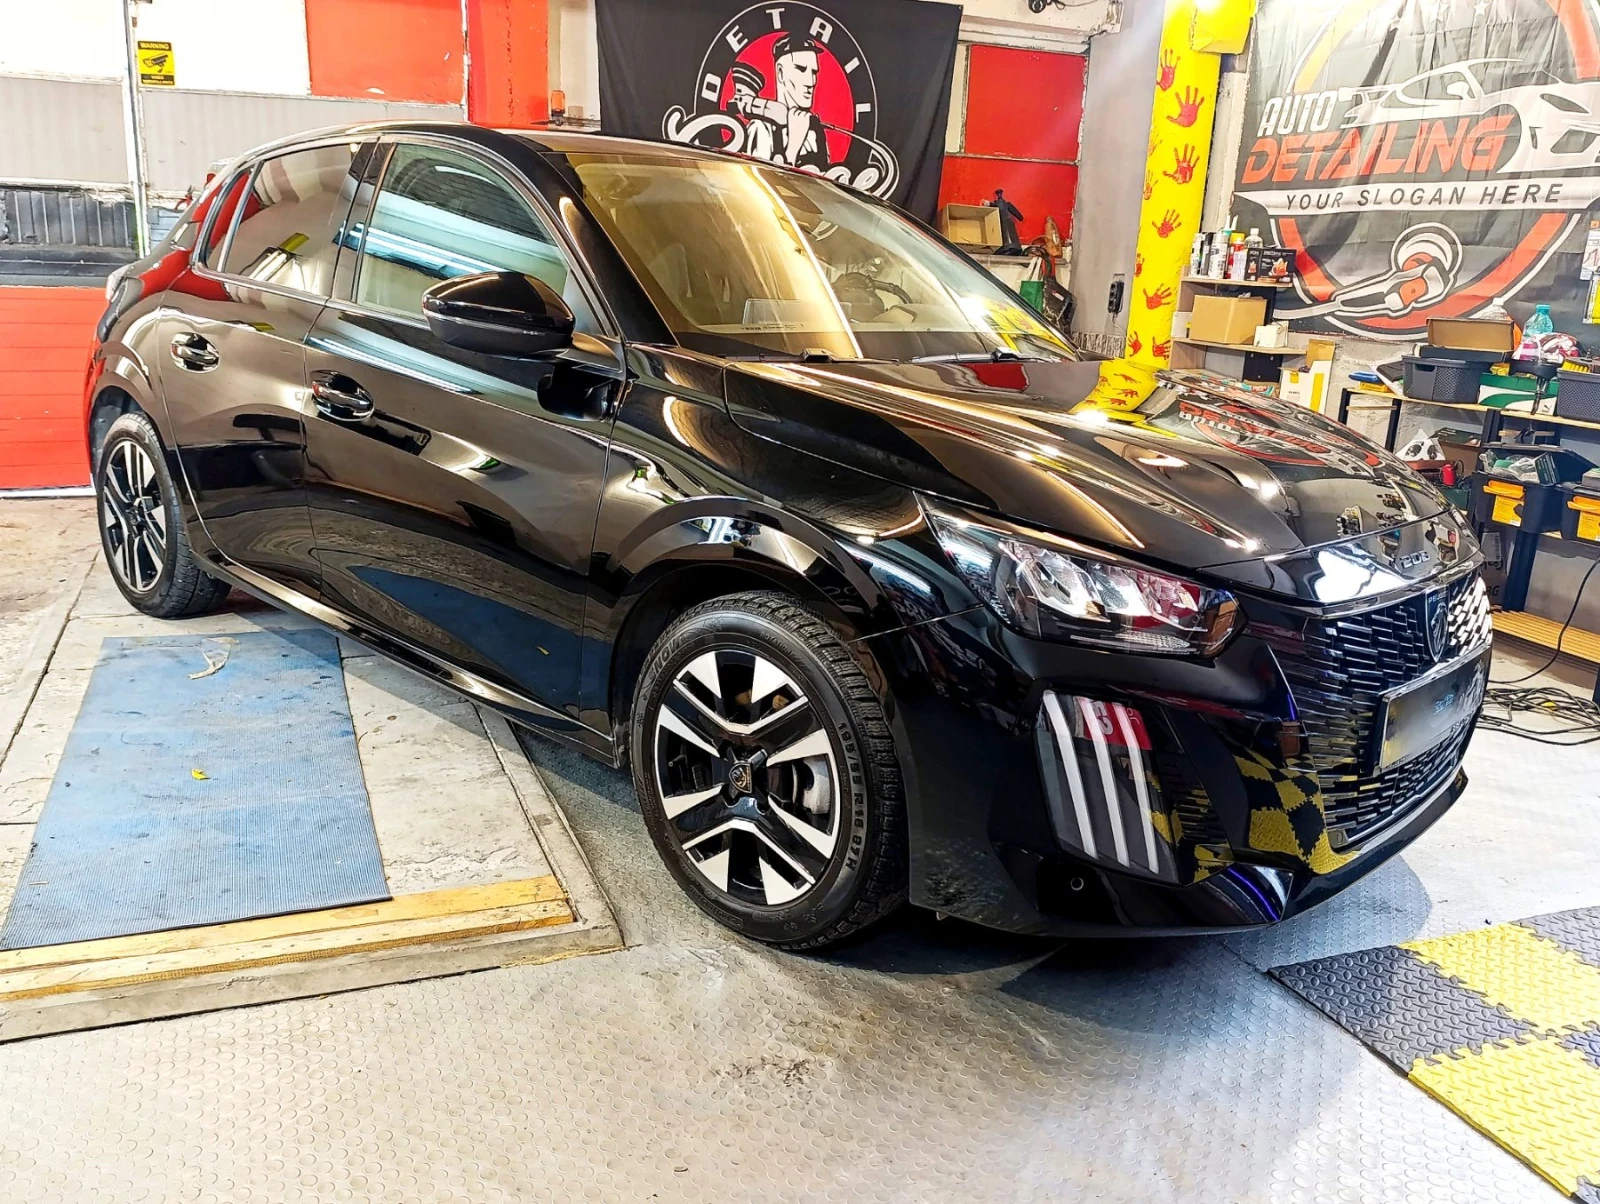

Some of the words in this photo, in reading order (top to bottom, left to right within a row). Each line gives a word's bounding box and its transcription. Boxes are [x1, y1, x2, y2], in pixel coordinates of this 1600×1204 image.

[700, 7, 873, 124] DETAIL
[1256, 90, 1338, 137] AUTO
[1241, 114, 1515, 184] DETAILING
[1286, 192, 1344, 210] YOUR
[1357, 187, 1466, 206] SLOGAN
[1479, 183, 1564, 204] HERE
[1400, 550, 1430, 568] 208
